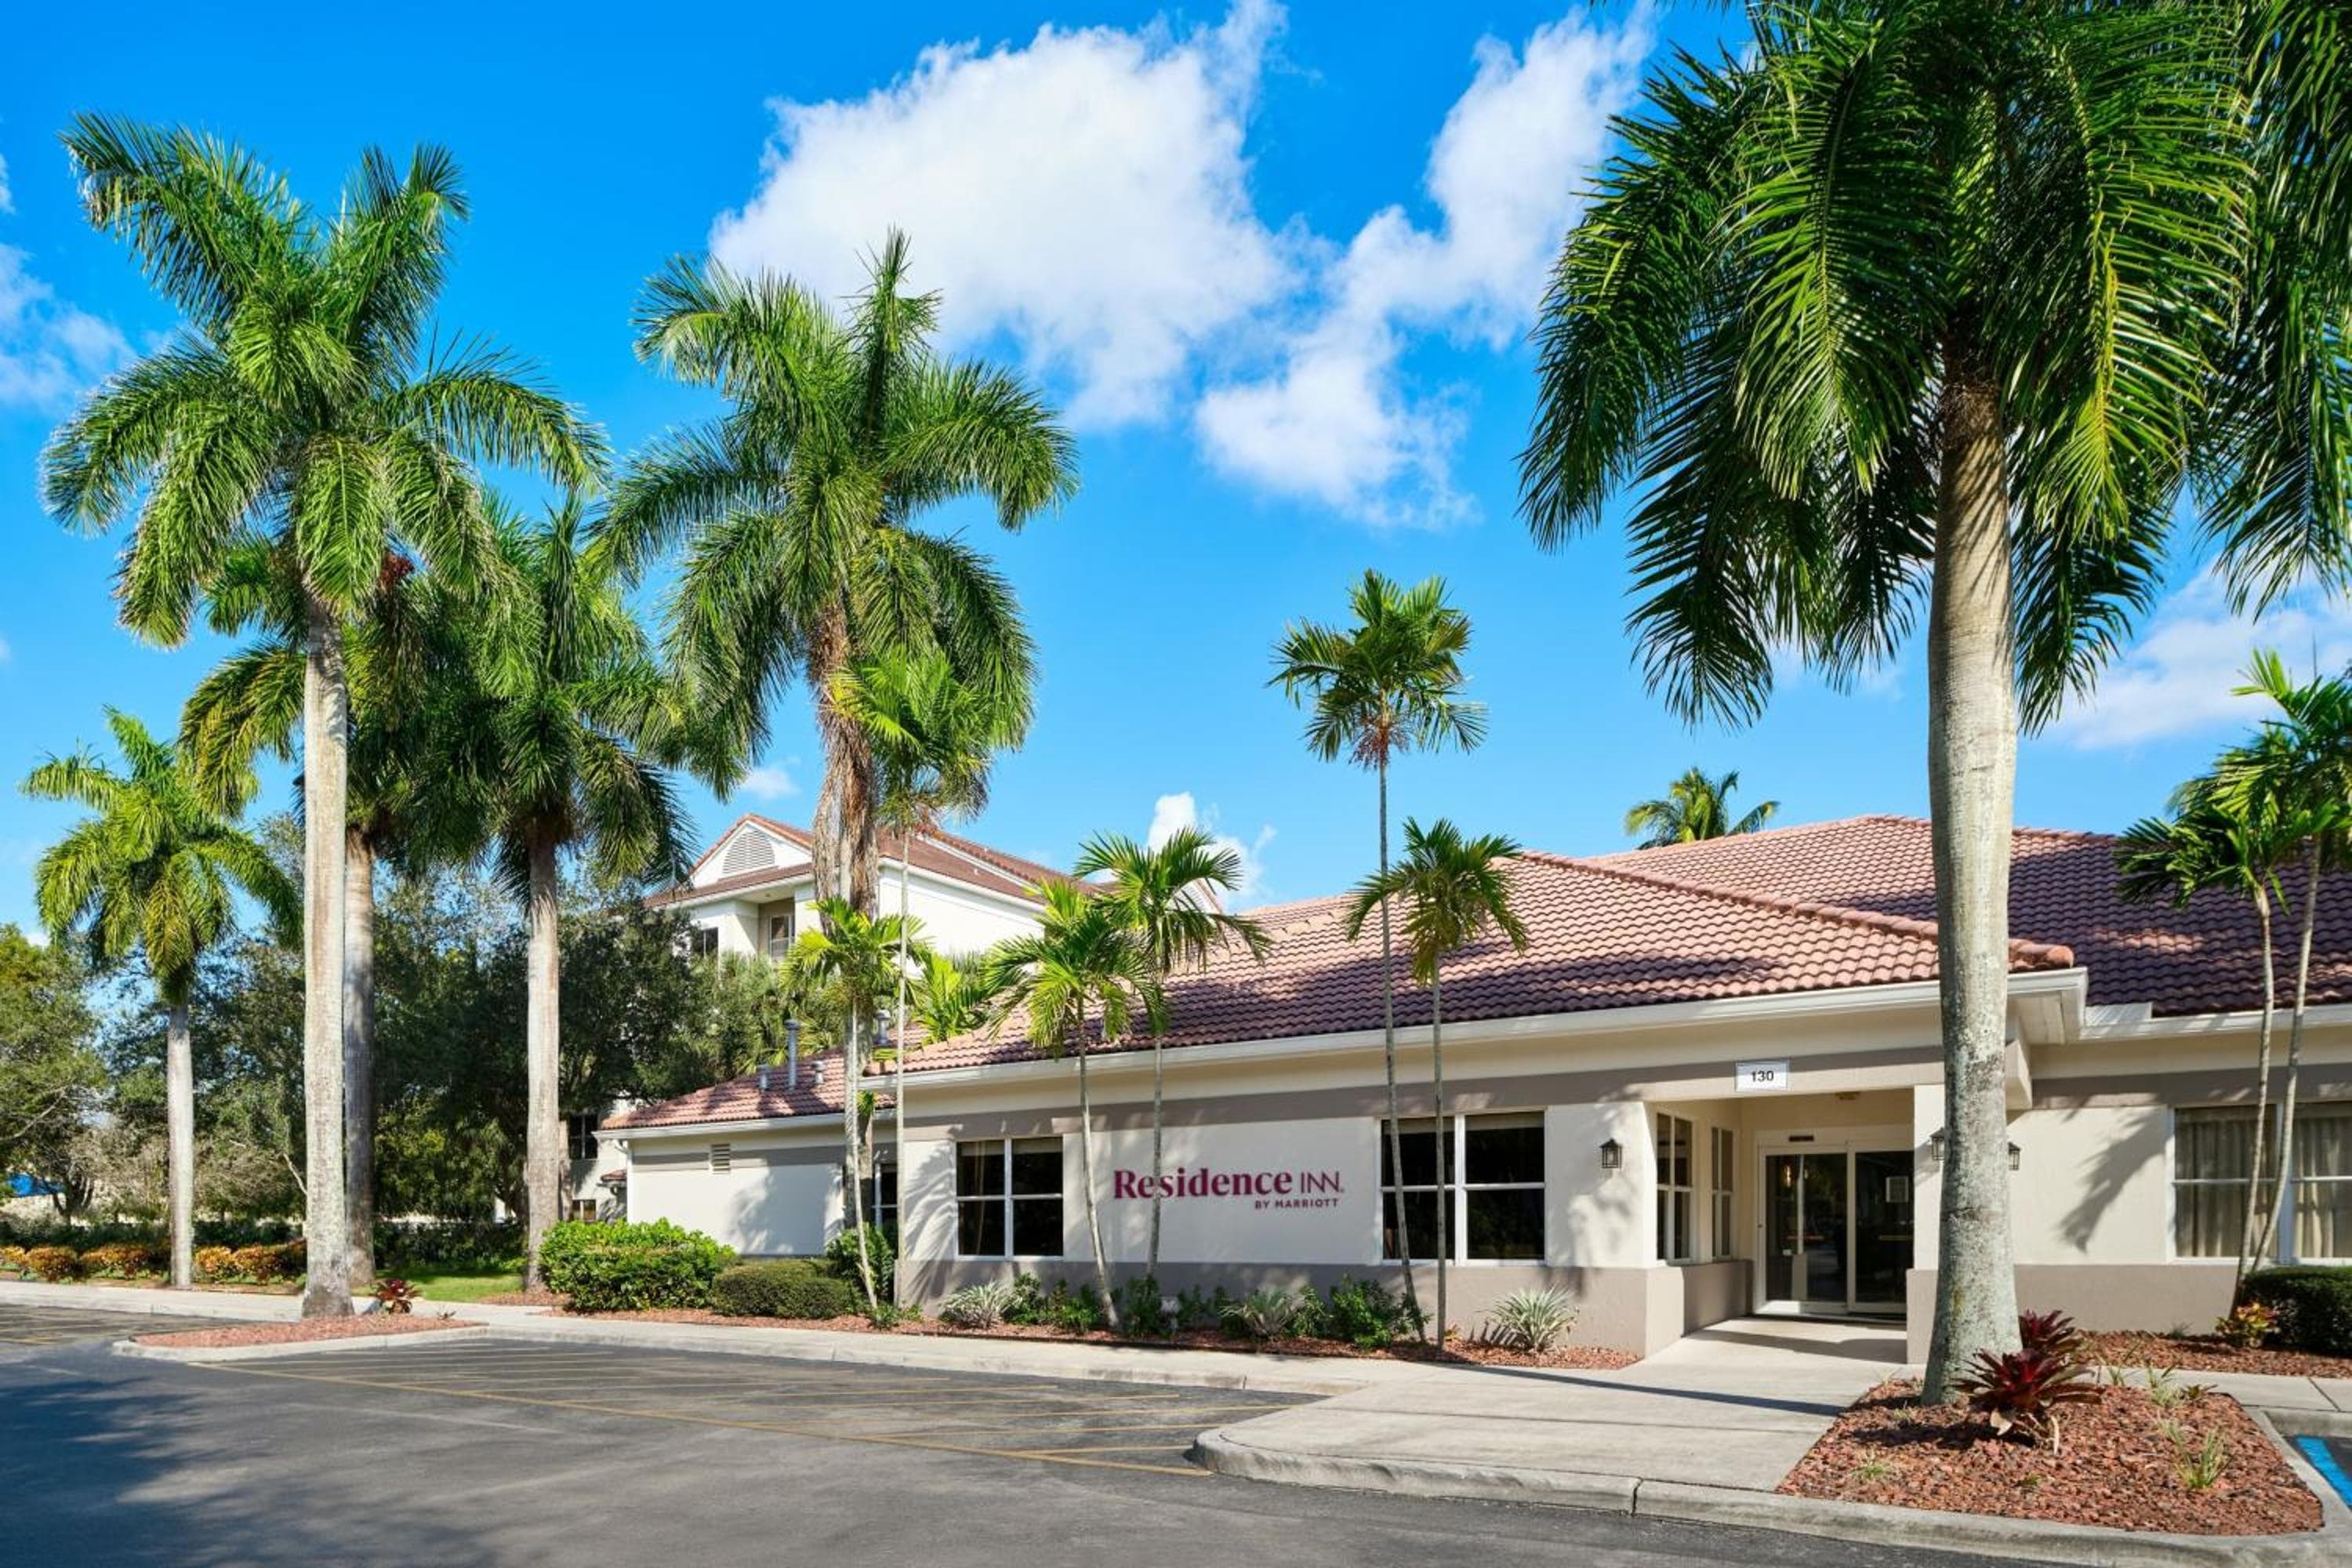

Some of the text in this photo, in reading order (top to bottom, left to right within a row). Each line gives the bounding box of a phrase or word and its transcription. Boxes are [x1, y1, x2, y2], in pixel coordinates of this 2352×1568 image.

[1751, 1070, 1774, 1082] 130
[1114, 1167, 1293, 1198] Residence
[1255, 1198, 1339, 1209] BY MARRIOTT
